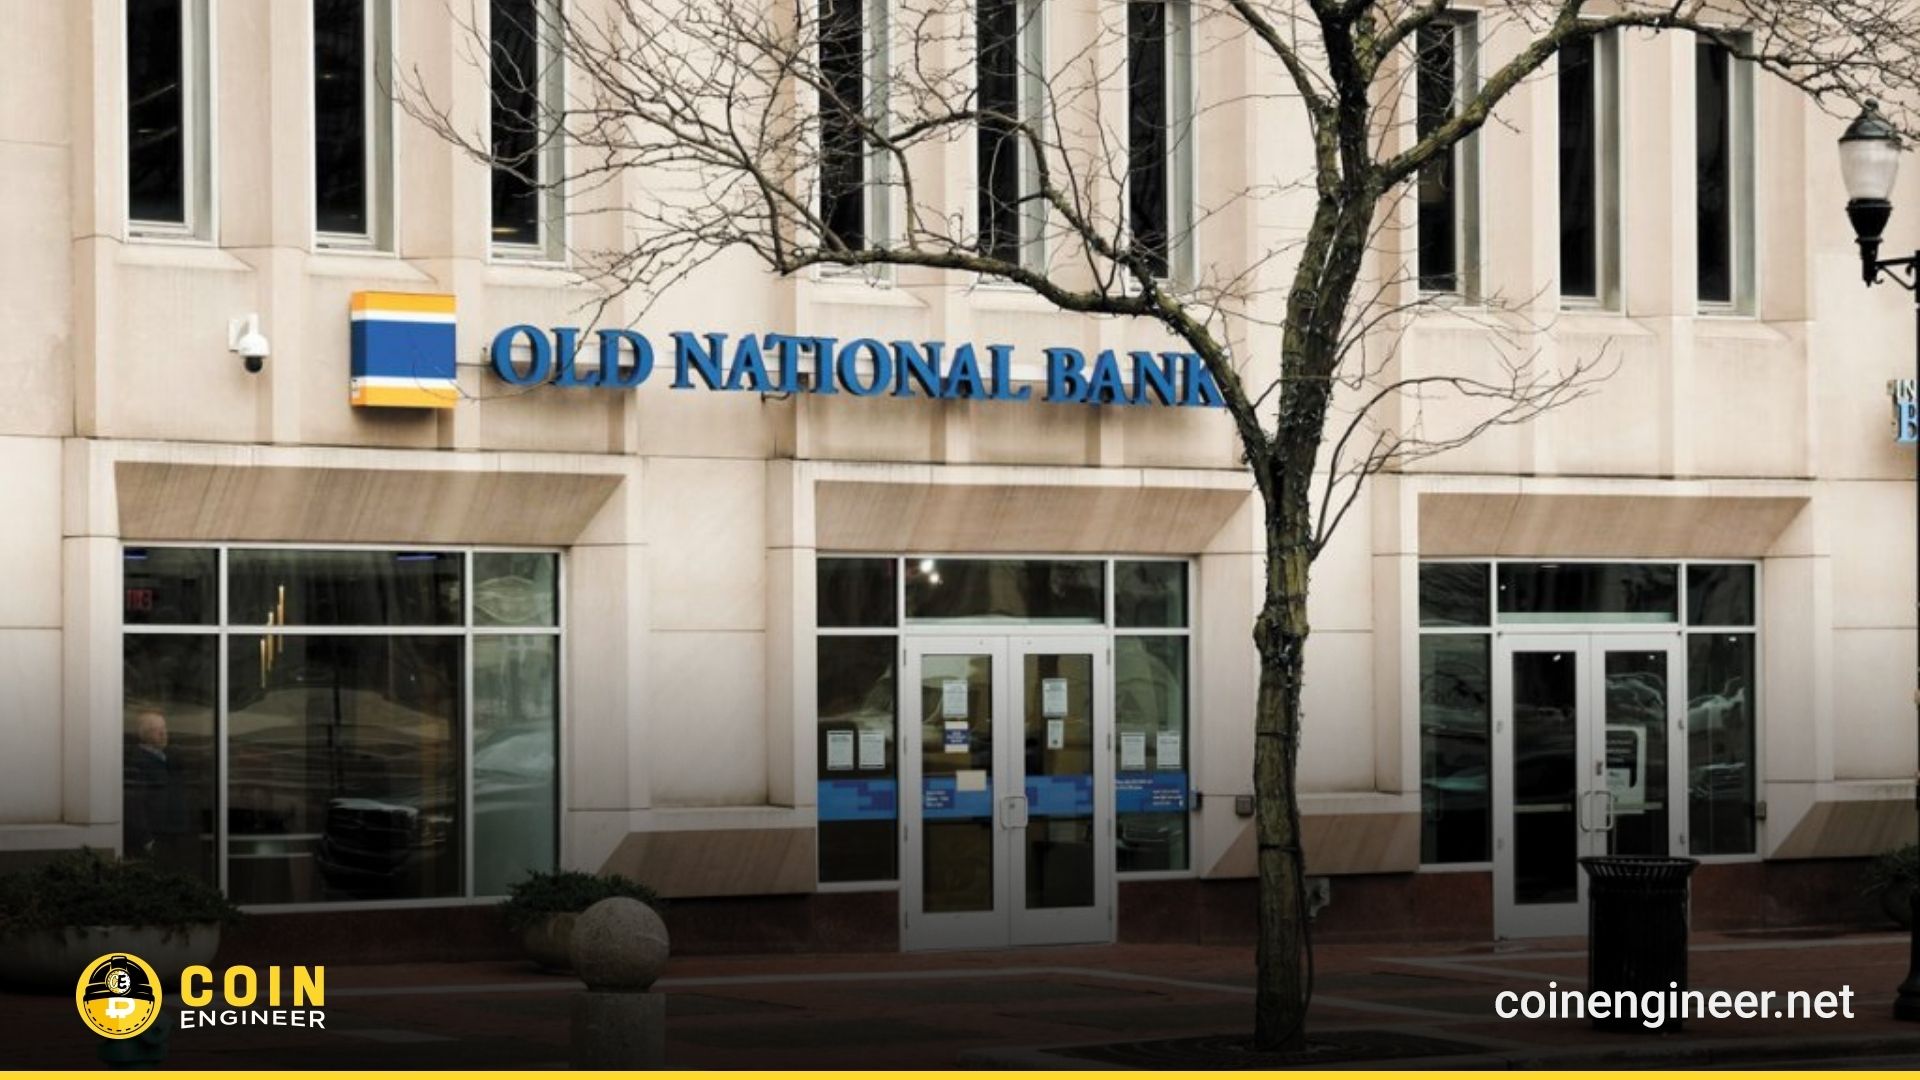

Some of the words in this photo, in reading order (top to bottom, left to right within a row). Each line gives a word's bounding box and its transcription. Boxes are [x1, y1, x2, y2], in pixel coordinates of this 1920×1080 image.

[491, 325, 654, 388] OLD
[669, 331, 1031, 402] NATIONAL
[1042, 347, 1227, 408] BANK
